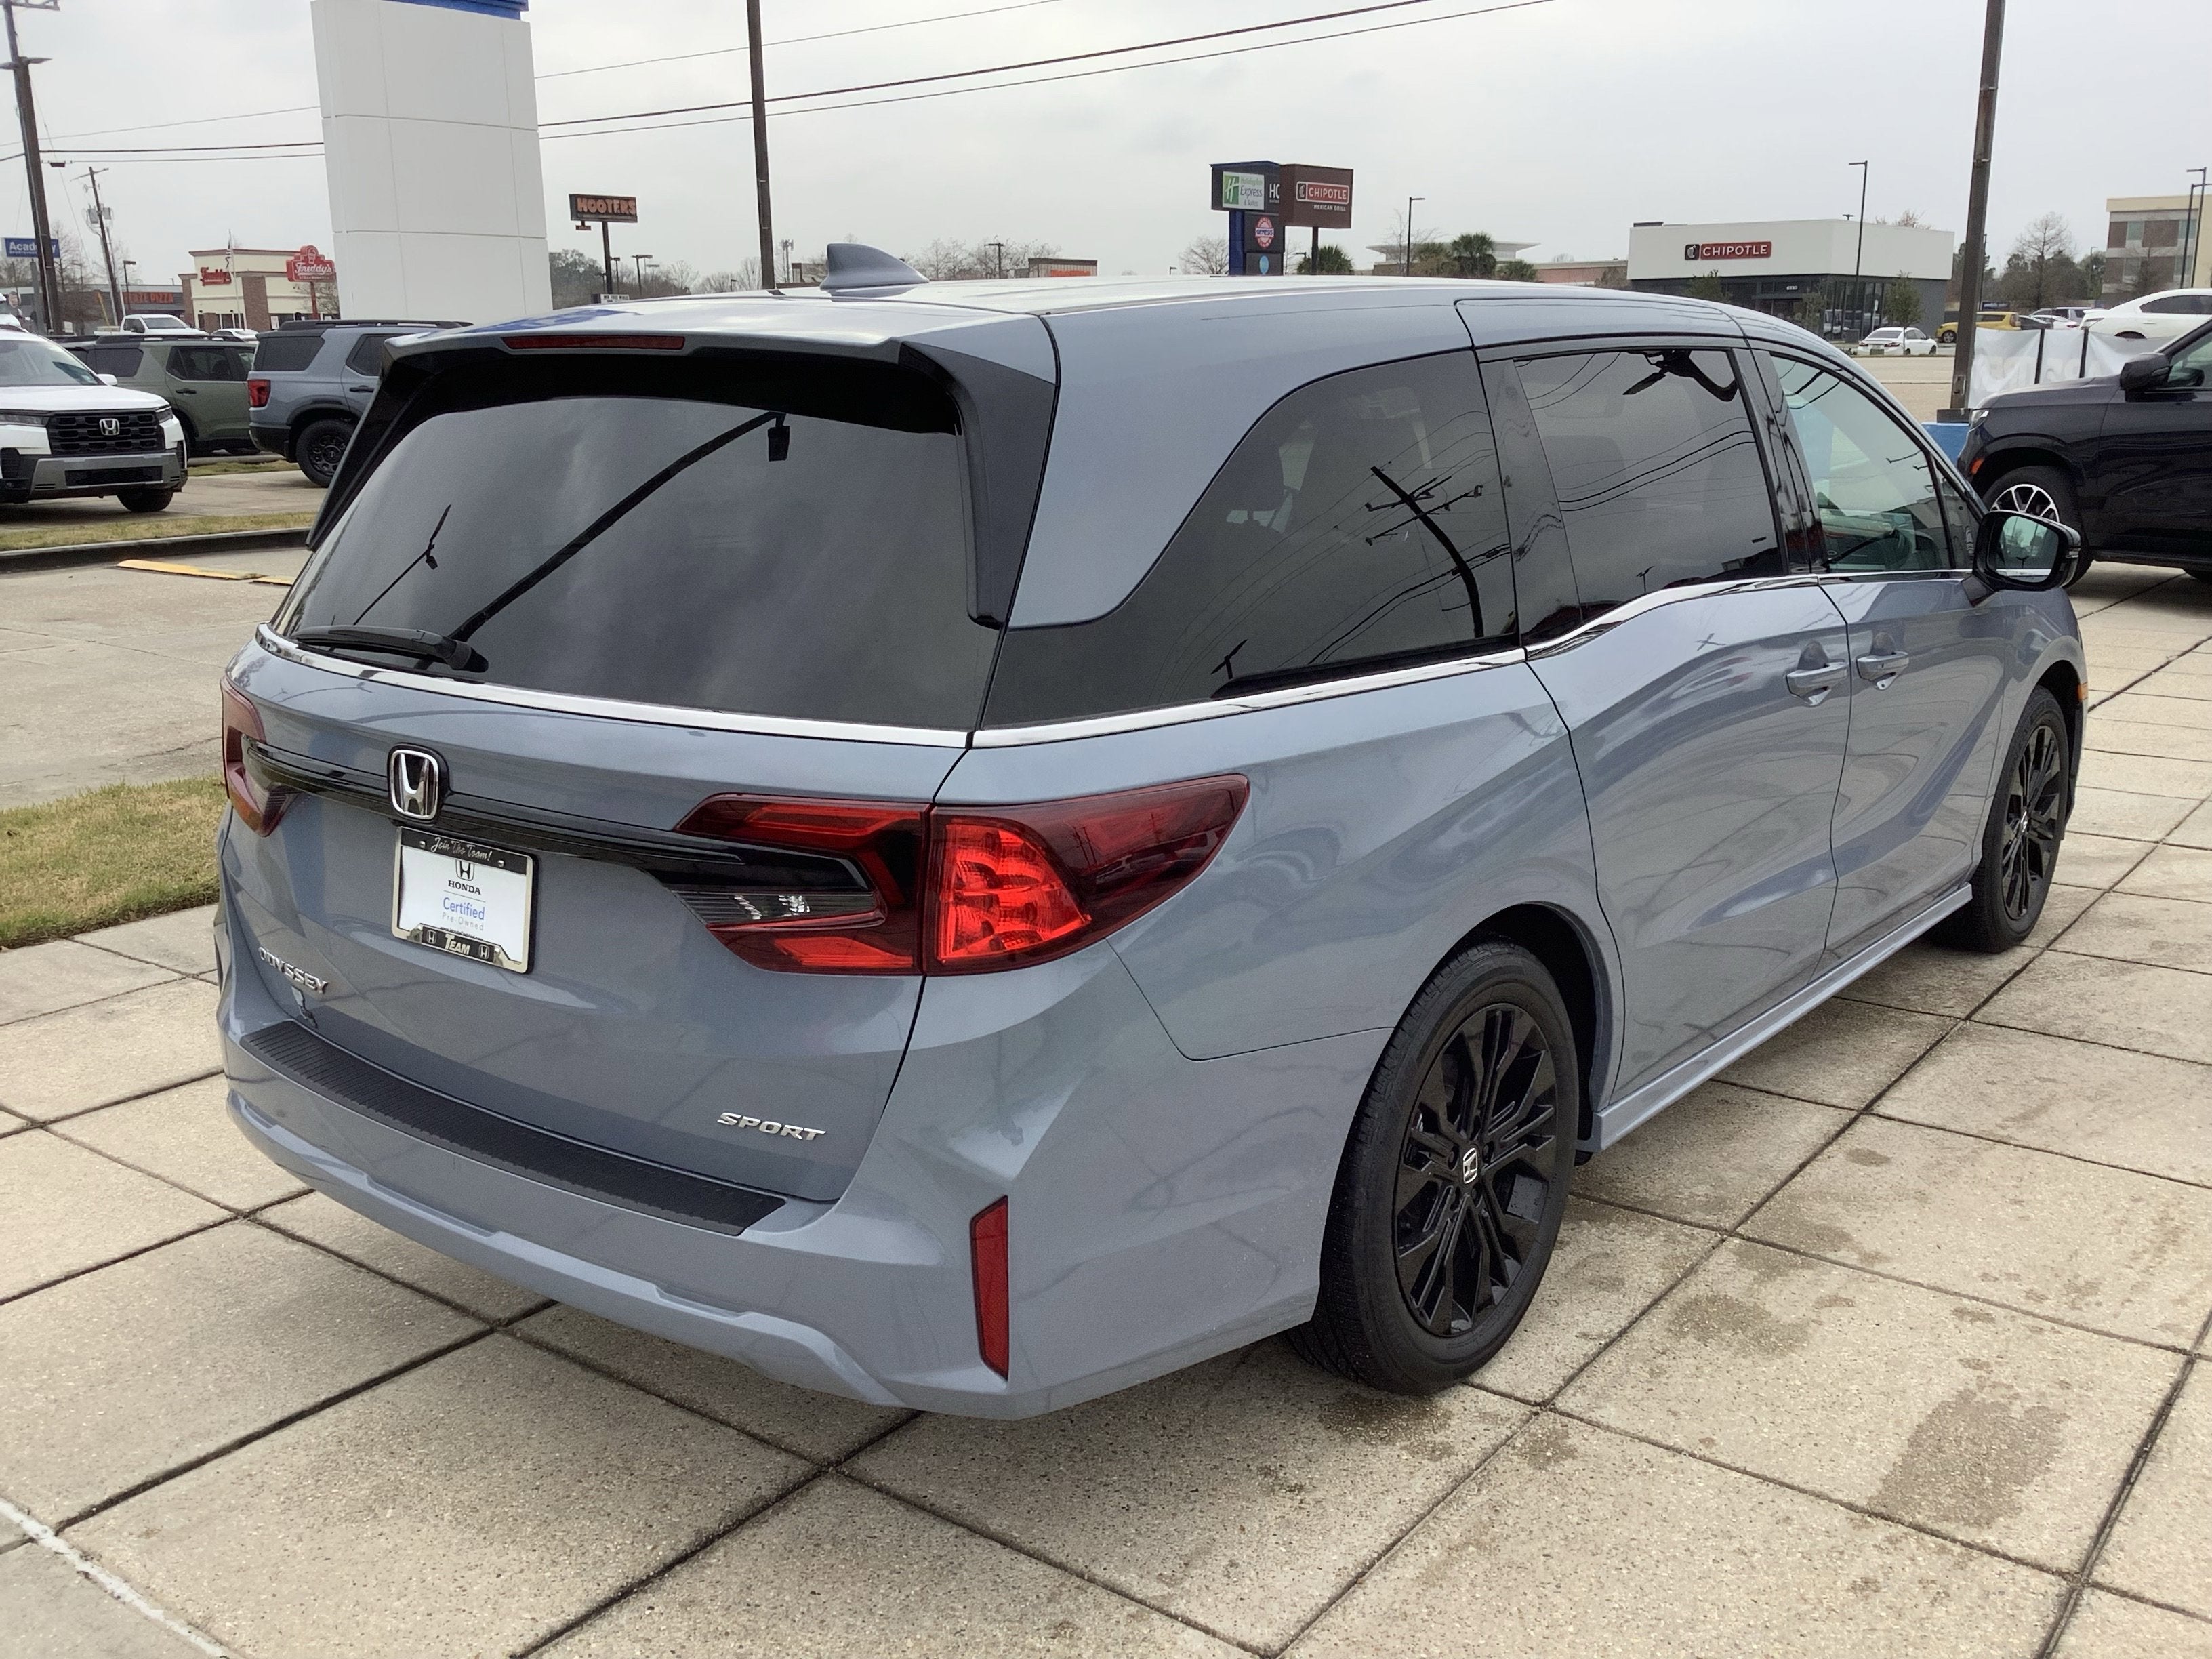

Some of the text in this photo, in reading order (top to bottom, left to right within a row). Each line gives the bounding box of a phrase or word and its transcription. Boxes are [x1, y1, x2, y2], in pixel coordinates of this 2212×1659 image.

[1240, 185, 1263, 199] Express
[1308, 187, 1347, 199] CHIPOTLE
[577, 197, 636, 215] HOOTERS
[9, 242, 56, 253] Acady
[1702, 245, 1767, 257] CHIPOTLE
[294, 262, 332, 274] Freddy's
[150, 292, 174, 304] PIZZA
[430, 836, 493, 861] Join The Team!
[448, 880, 482, 895] HONDA
[443, 897, 485, 921] Certified
[445, 933, 470, 956] TEAM
[259, 947, 329, 994] ODYSSEY
[717, 1112, 826, 1141] SPORT
